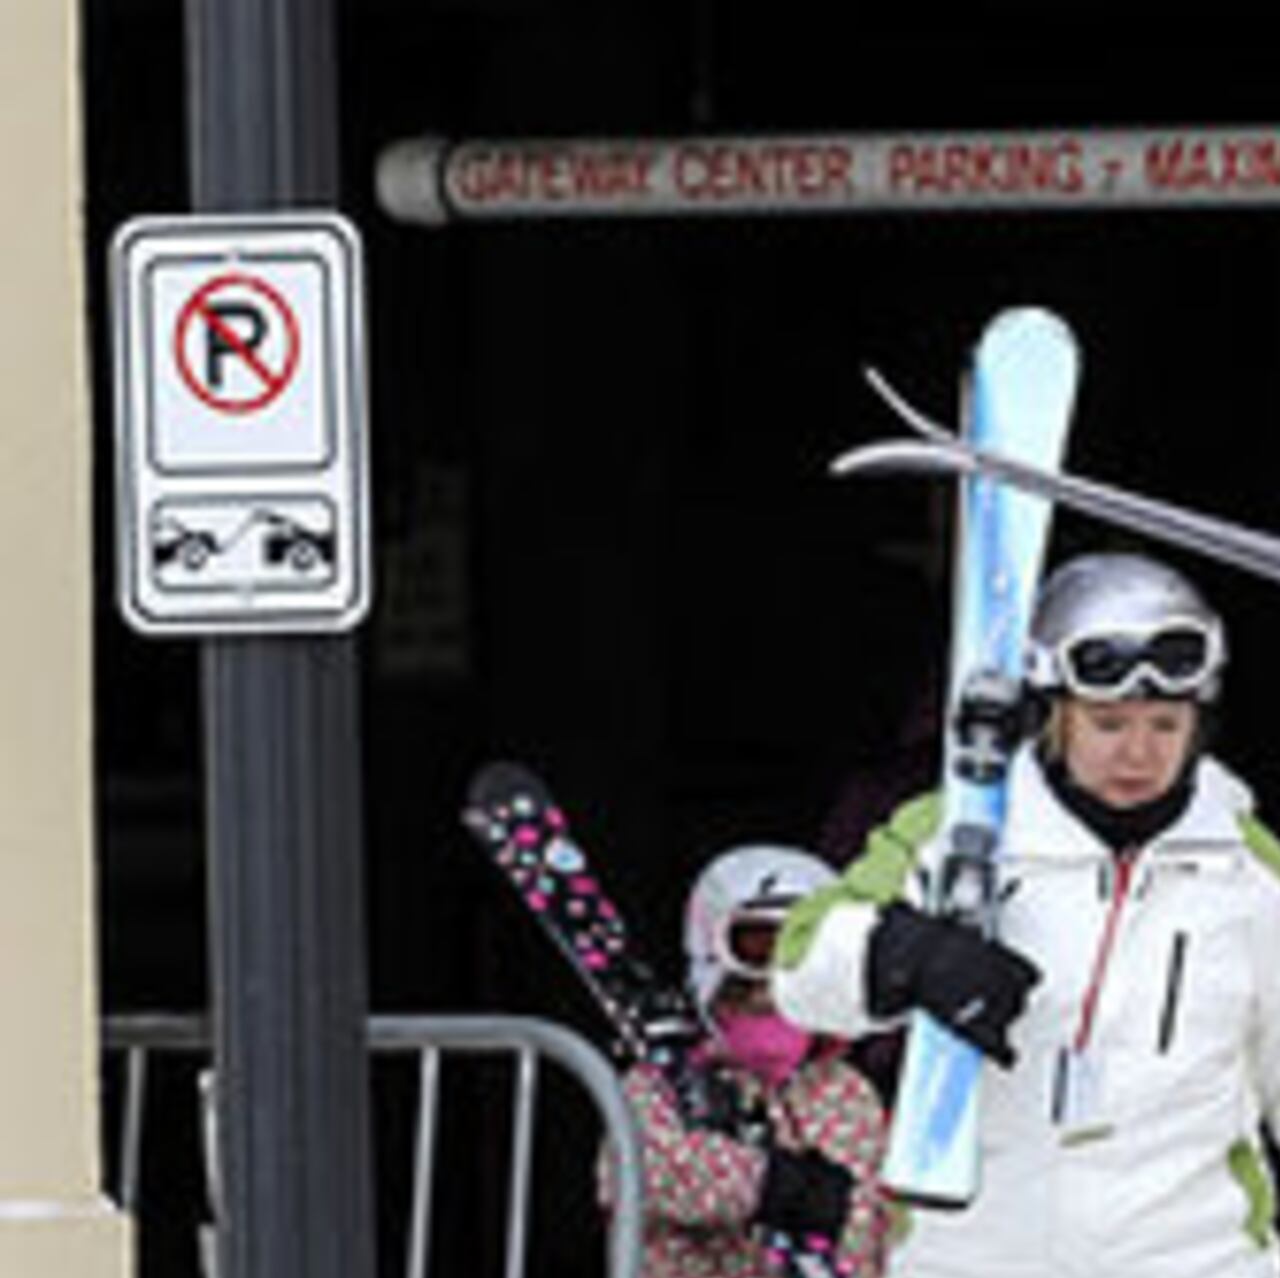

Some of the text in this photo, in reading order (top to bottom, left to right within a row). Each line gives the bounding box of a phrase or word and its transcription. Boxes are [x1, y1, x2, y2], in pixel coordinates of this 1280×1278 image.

[458, 144, 651, 201] GATEWAY
[673, 141, 854, 199] CENTER
[887, 137, 1084, 194] PARKING
